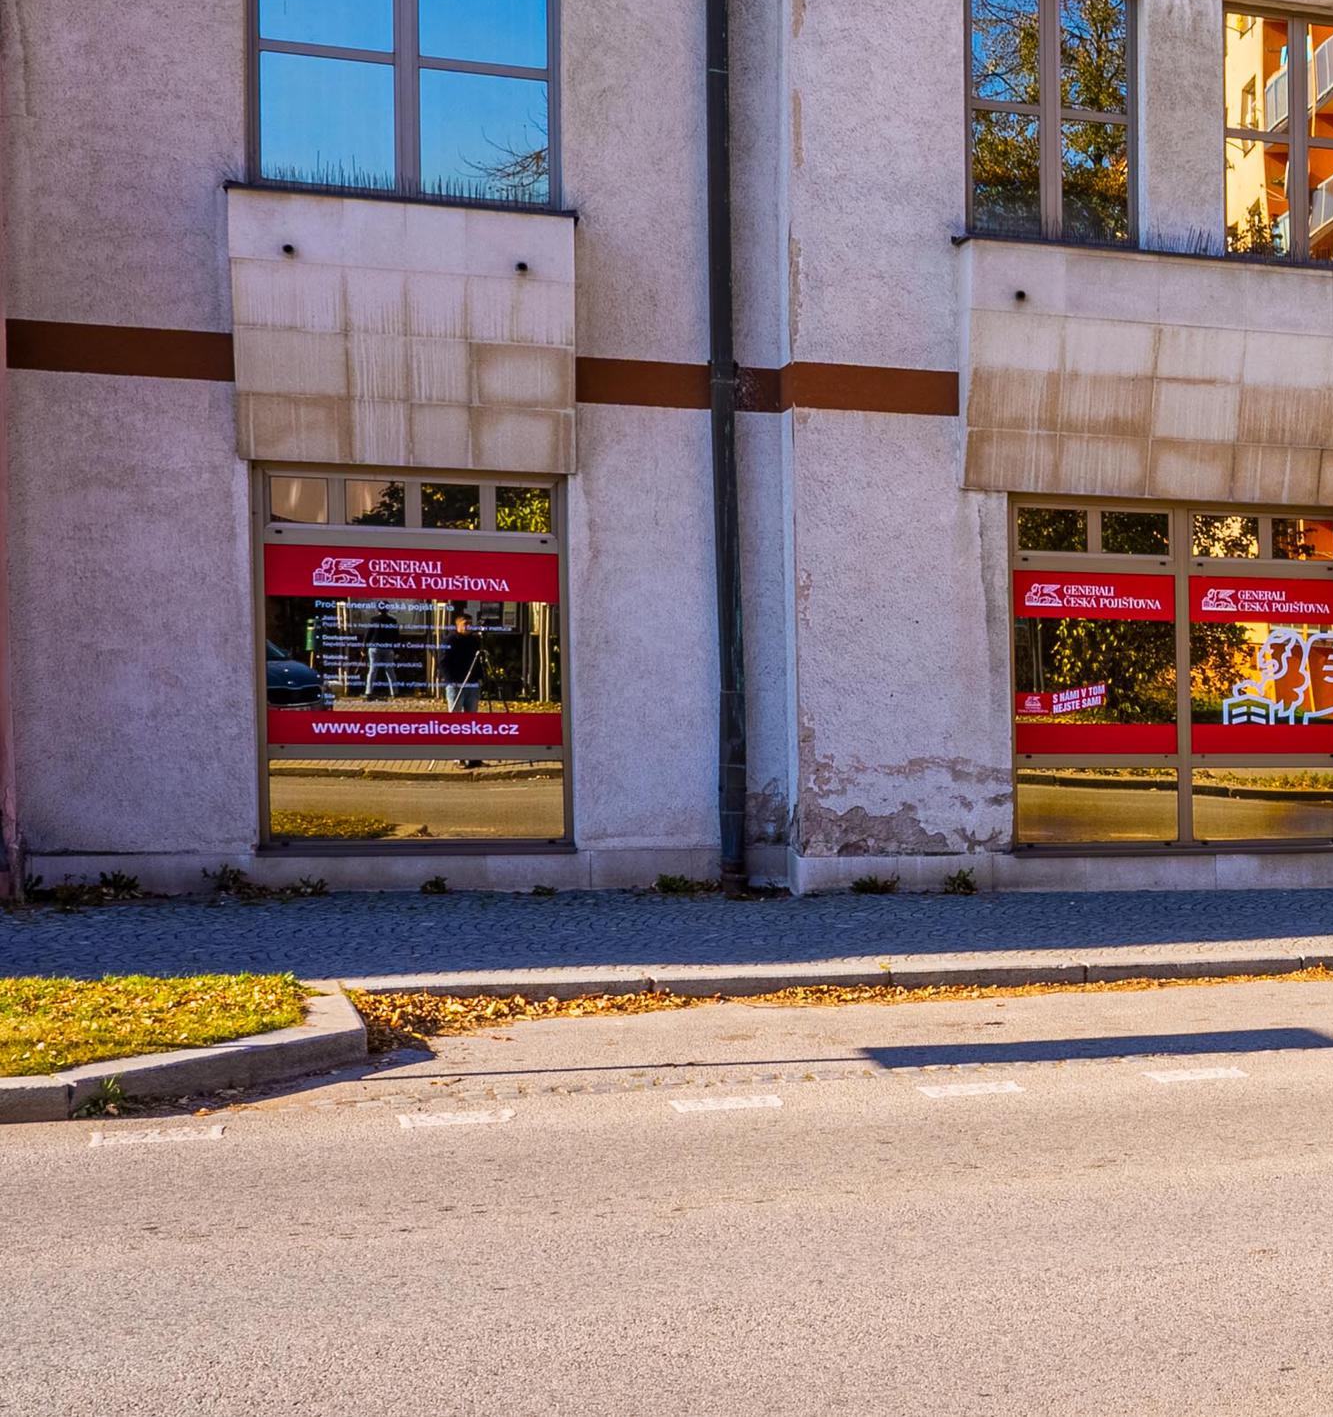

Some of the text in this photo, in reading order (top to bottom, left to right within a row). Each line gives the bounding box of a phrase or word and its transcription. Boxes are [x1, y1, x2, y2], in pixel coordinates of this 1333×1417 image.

[368, 559, 442, 574] GENERALI
[369, 573, 510, 592] ČESKÁ POJIŠŤOVNA
[1063, 584, 1114, 596] GENERALI
[1063, 595, 1161, 610] ČESKÁ POJIŠŤOVNA
[1237, 590, 1286, 601] GENERALI
[315, 600, 336, 608] Proč
[378, 600, 406, 610] Česká
[1238, 600, 1330, 614] ČESKÁ POJIŠŤOVNA
[1052, 684, 1106, 703] S NÁMI V TOM
[1052, 700, 1081, 714] NEJSTE
[1081, 695, 1102, 710] SAMI
[312, 721, 519, 737] www.generaliceska.cz
